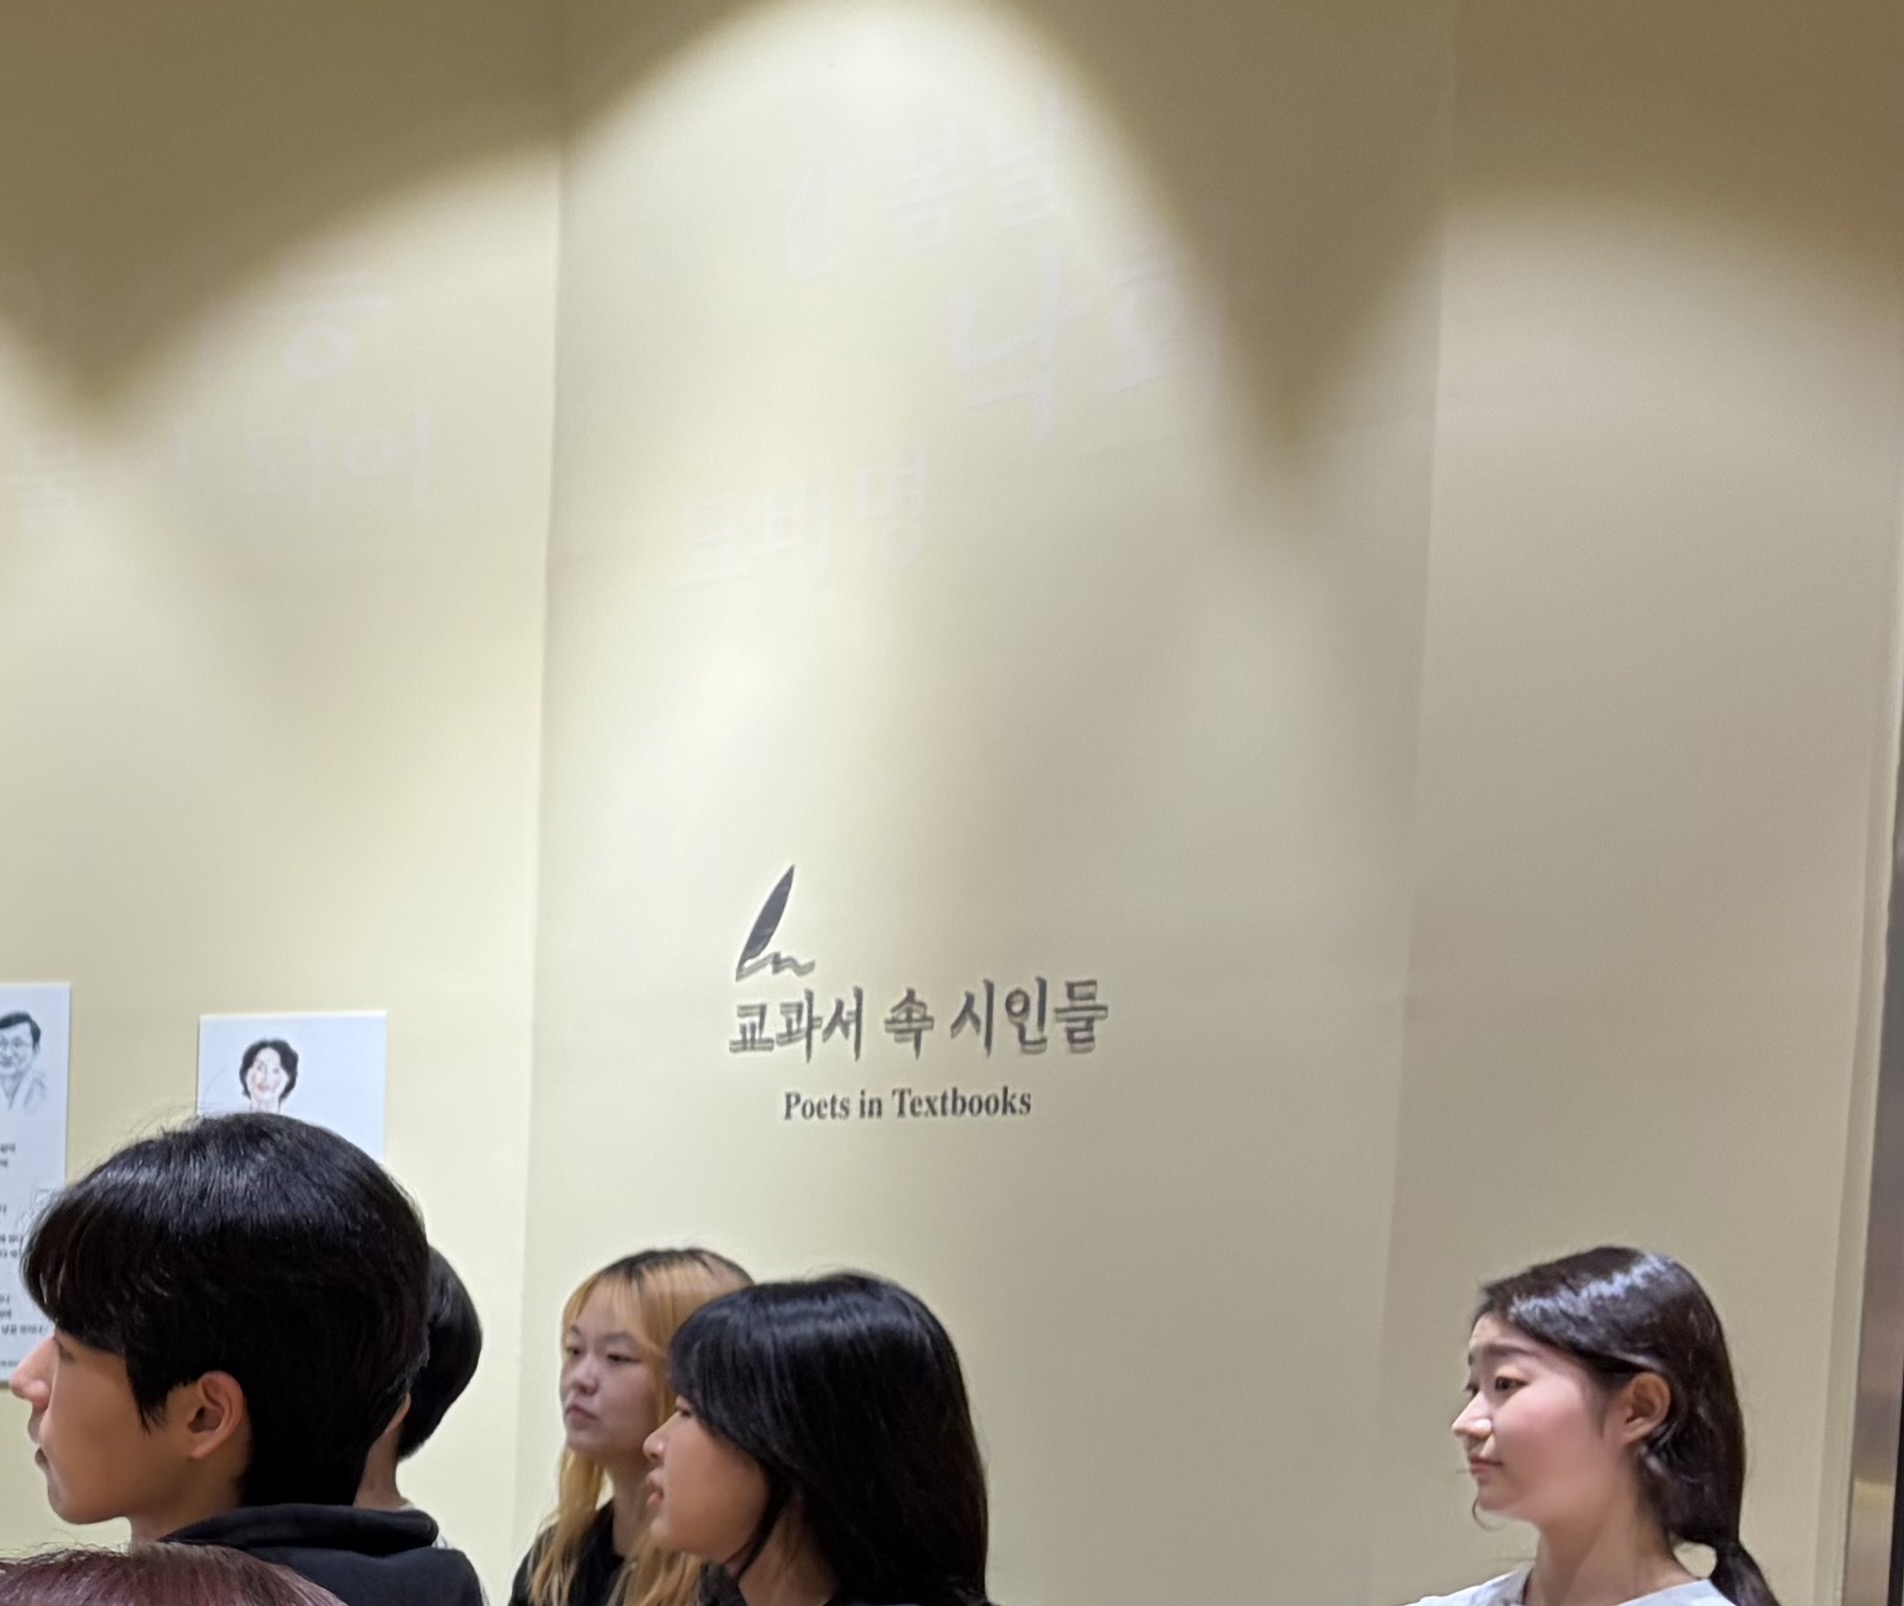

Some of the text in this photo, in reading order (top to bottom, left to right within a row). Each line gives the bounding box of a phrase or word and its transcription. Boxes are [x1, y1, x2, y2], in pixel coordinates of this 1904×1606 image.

[729, 976, 1108, 1063] 교과서 속 시인들
[784, 1085, 1032, 1120] Poets in Textbooks
